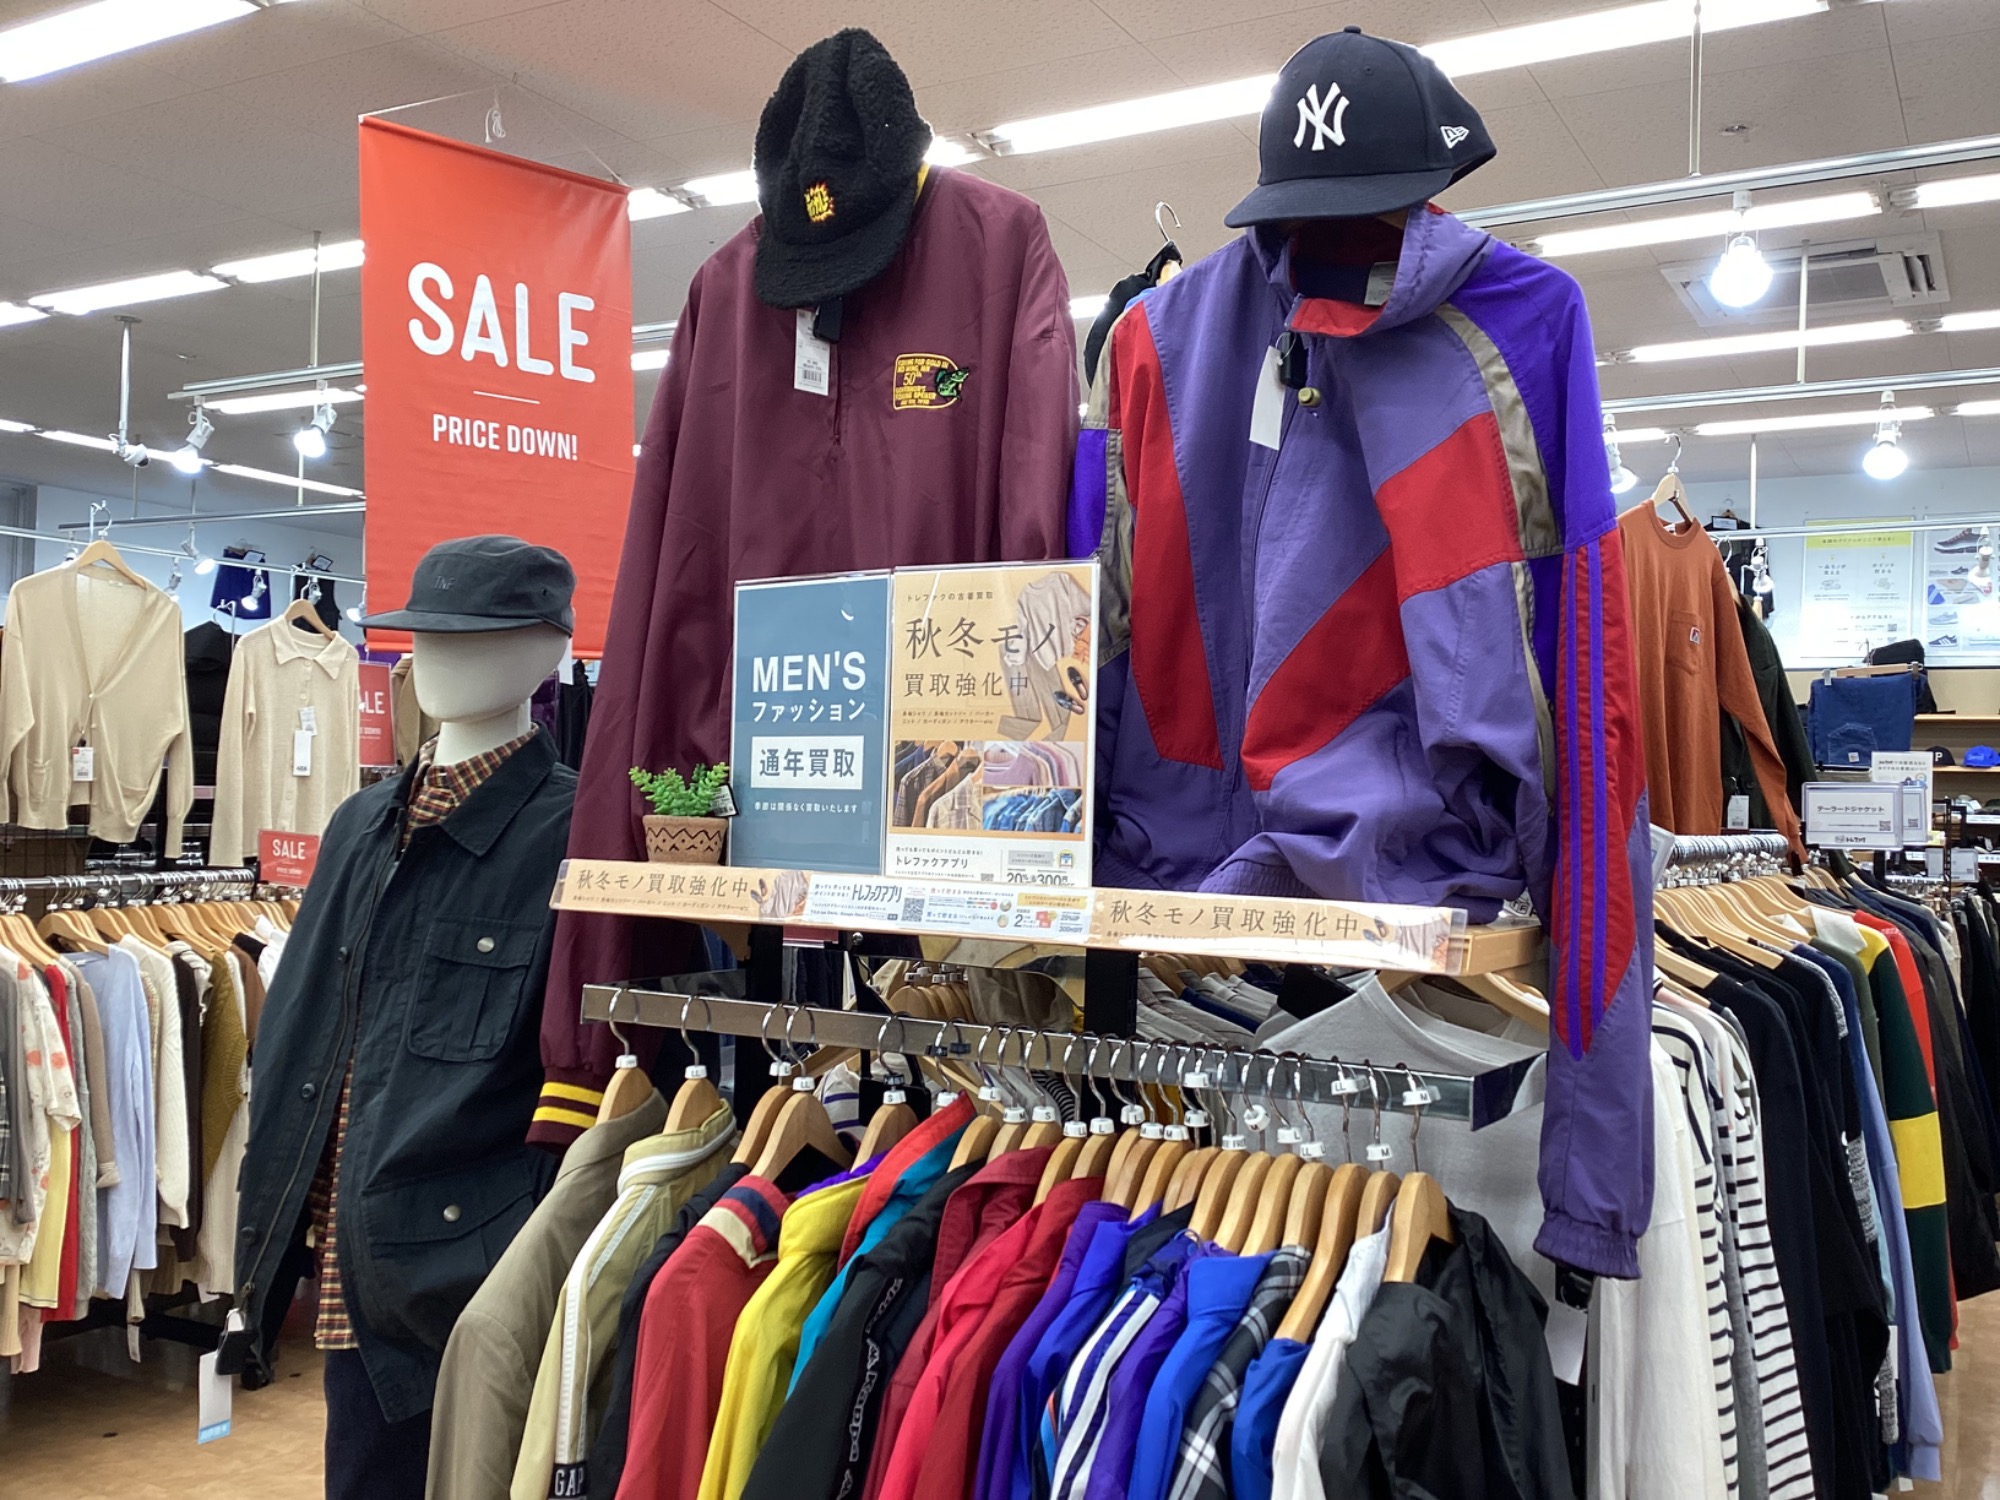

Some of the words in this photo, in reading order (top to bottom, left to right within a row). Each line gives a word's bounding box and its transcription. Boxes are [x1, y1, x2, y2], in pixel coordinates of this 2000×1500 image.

[1293, 82, 1350, 151] NY
[407, 261, 596, 384] SALE
[433, 413, 500, 451] PRICE
[507, 424, 578, 461] DOWN!
[907, 591, 994, 602] トレファクの古着買取
[905, 616, 1056, 660] 秋冬モノ
[752, 651, 866, 692] MEN'S
[904, 671, 1029, 699] 買取強化中
[752, 697, 866, 723] ファッション
[759, 748, 856, 777] 通年買取
[754, 801, 858, 814] 季節は関係なく買取いたします
[1817, 805, 1885, 813] テーラードジャケット
[272, 838, 306, 860] SALE
[896, 855, 968, 869] トレファクアプリ
[577, 869, 748, 897] 秋冬モノ買取強化中
[851, 883, 903, 904] トレファクアプリ
[1109, 898, 1359, 939] 秋冬モノ買取強化中
[989, 1090, 996, 1099] L
[1335, 1083, 1346, 1092] LL
[1420, 1093, 1428, 1101] M
[1045, 1111, 1052, 1120] S
[1381, 1148, 1389, 1157] M
[848, 1371, 878, 1463] Kappa
[554, 1467, 584, 1497] GAP
